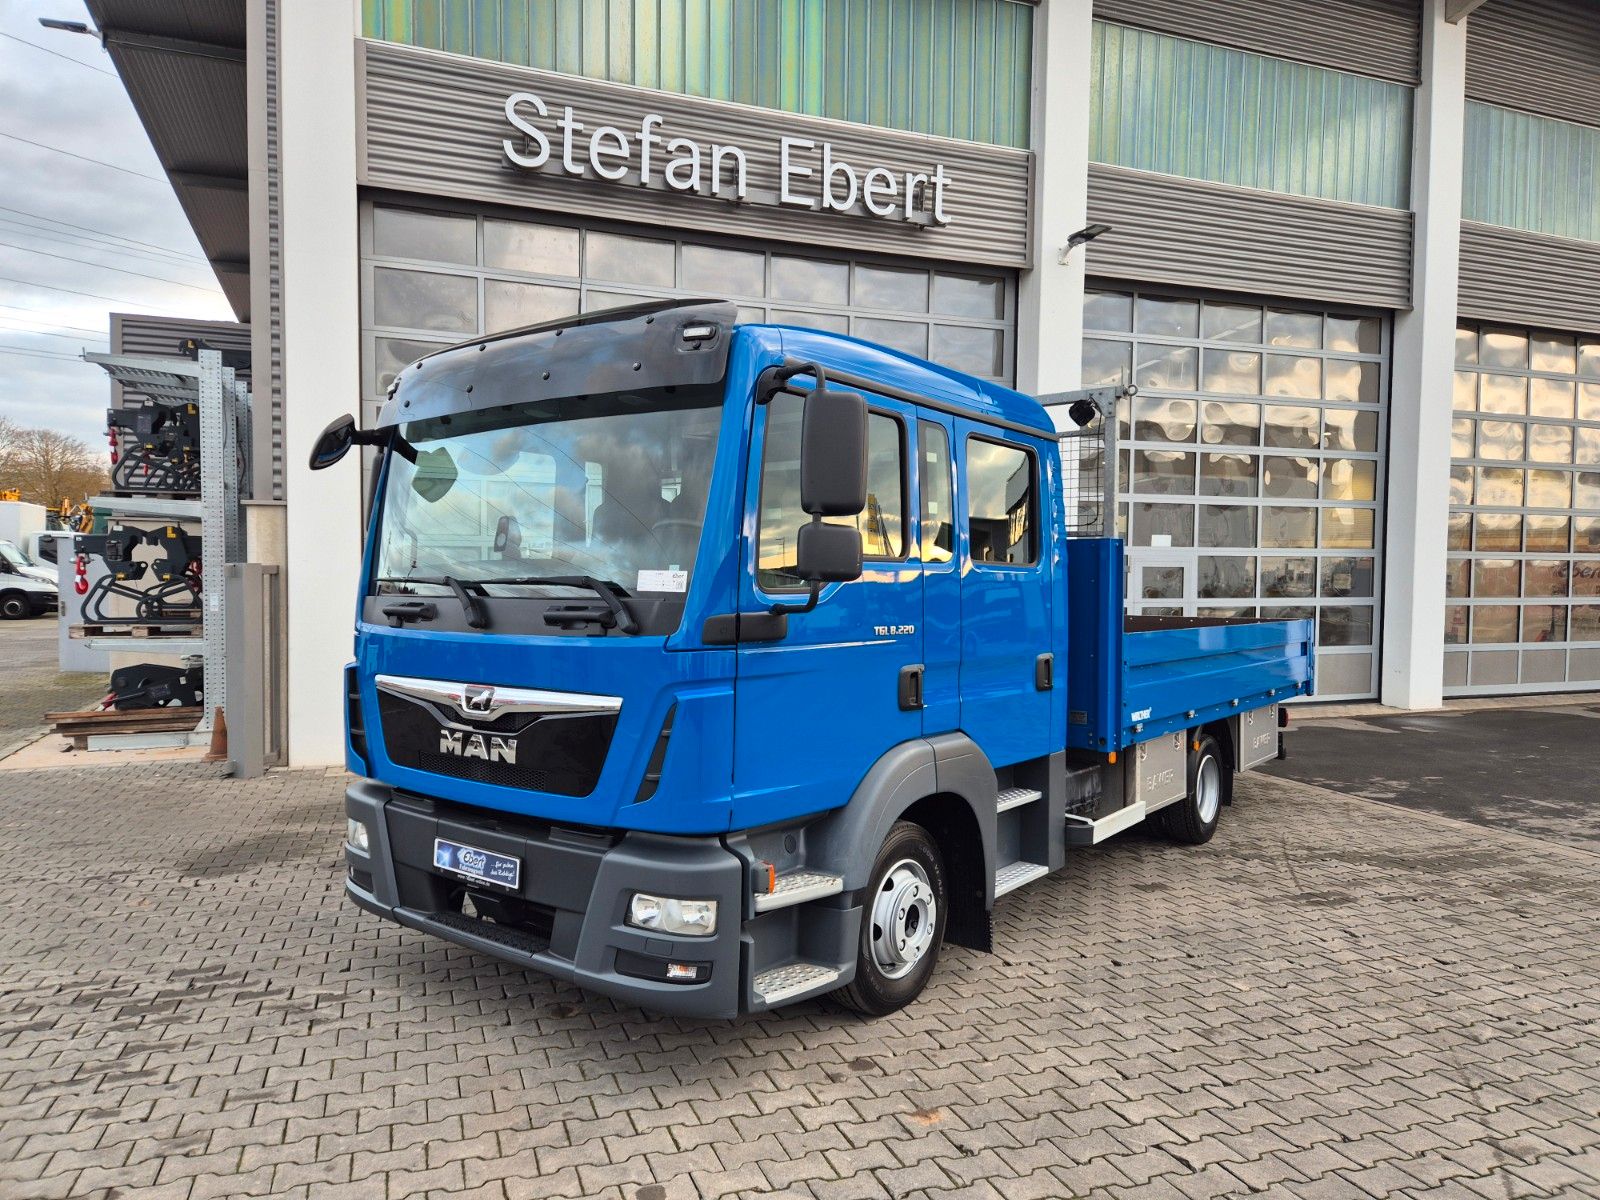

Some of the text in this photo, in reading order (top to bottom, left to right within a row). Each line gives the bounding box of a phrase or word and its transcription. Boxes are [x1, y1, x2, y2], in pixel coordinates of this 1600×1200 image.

[502, 91, 952, 225] Stefan Ebert
[873, 624, 915, 636] TGL 8.220
[440, 729, 517, 765] MAN
